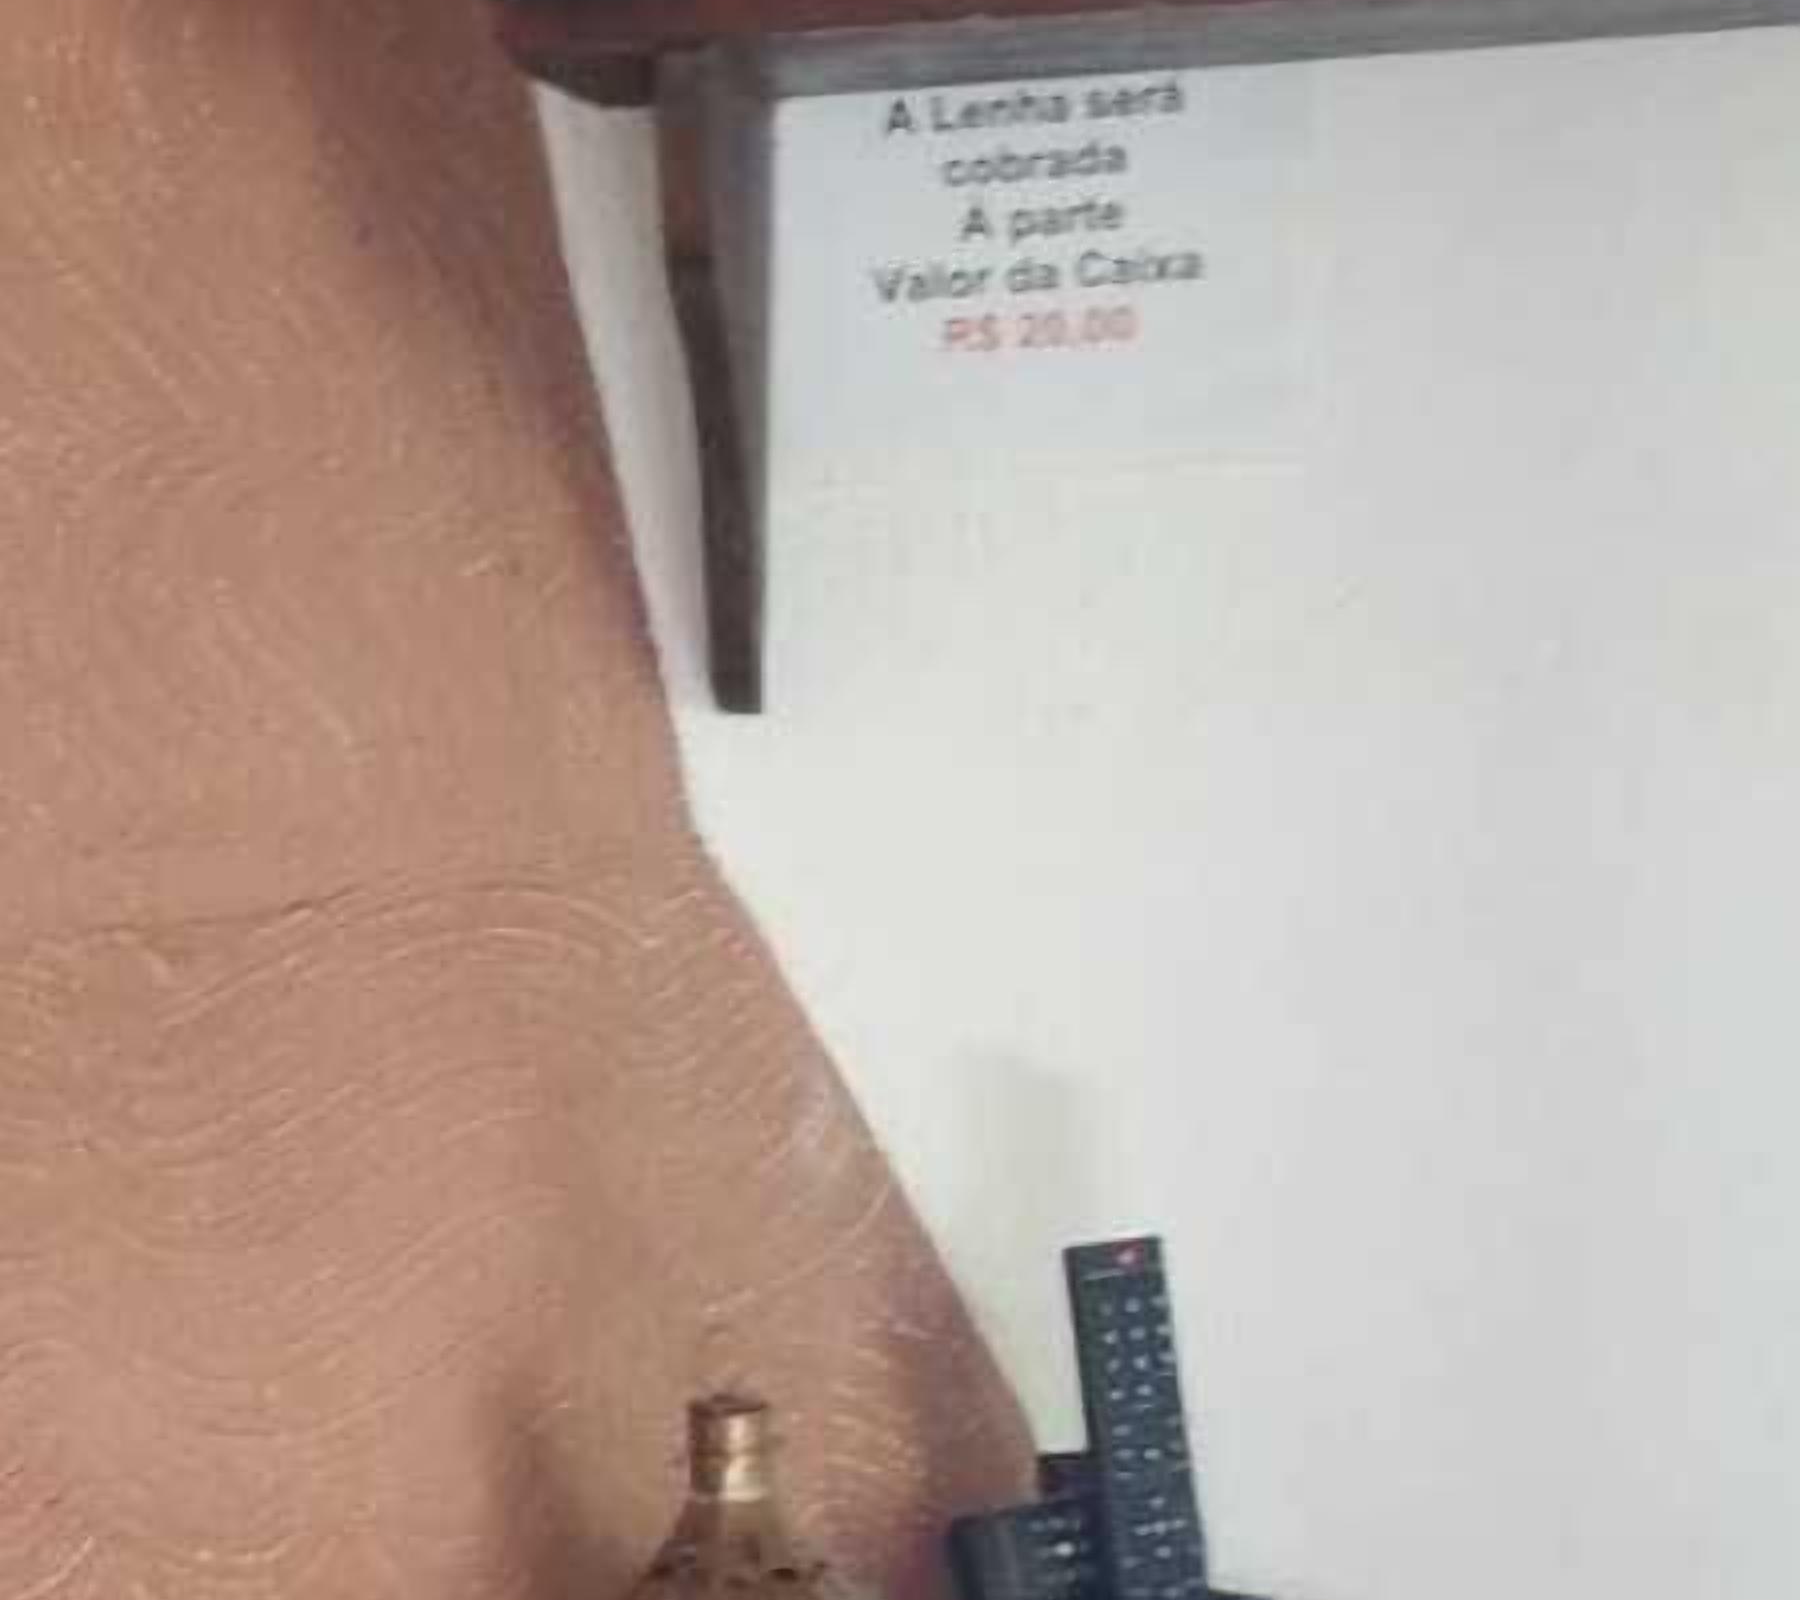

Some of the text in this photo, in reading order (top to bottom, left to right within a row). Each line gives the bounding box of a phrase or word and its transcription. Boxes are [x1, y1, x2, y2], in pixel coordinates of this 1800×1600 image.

[887, 97, 914, 131] A
[943, 142, 1127, 187] cobrada
[1008, 200, 1126, 246] parte
[870, 264, 992, 302] Valor
[1006, 258, 1059, 295] da
